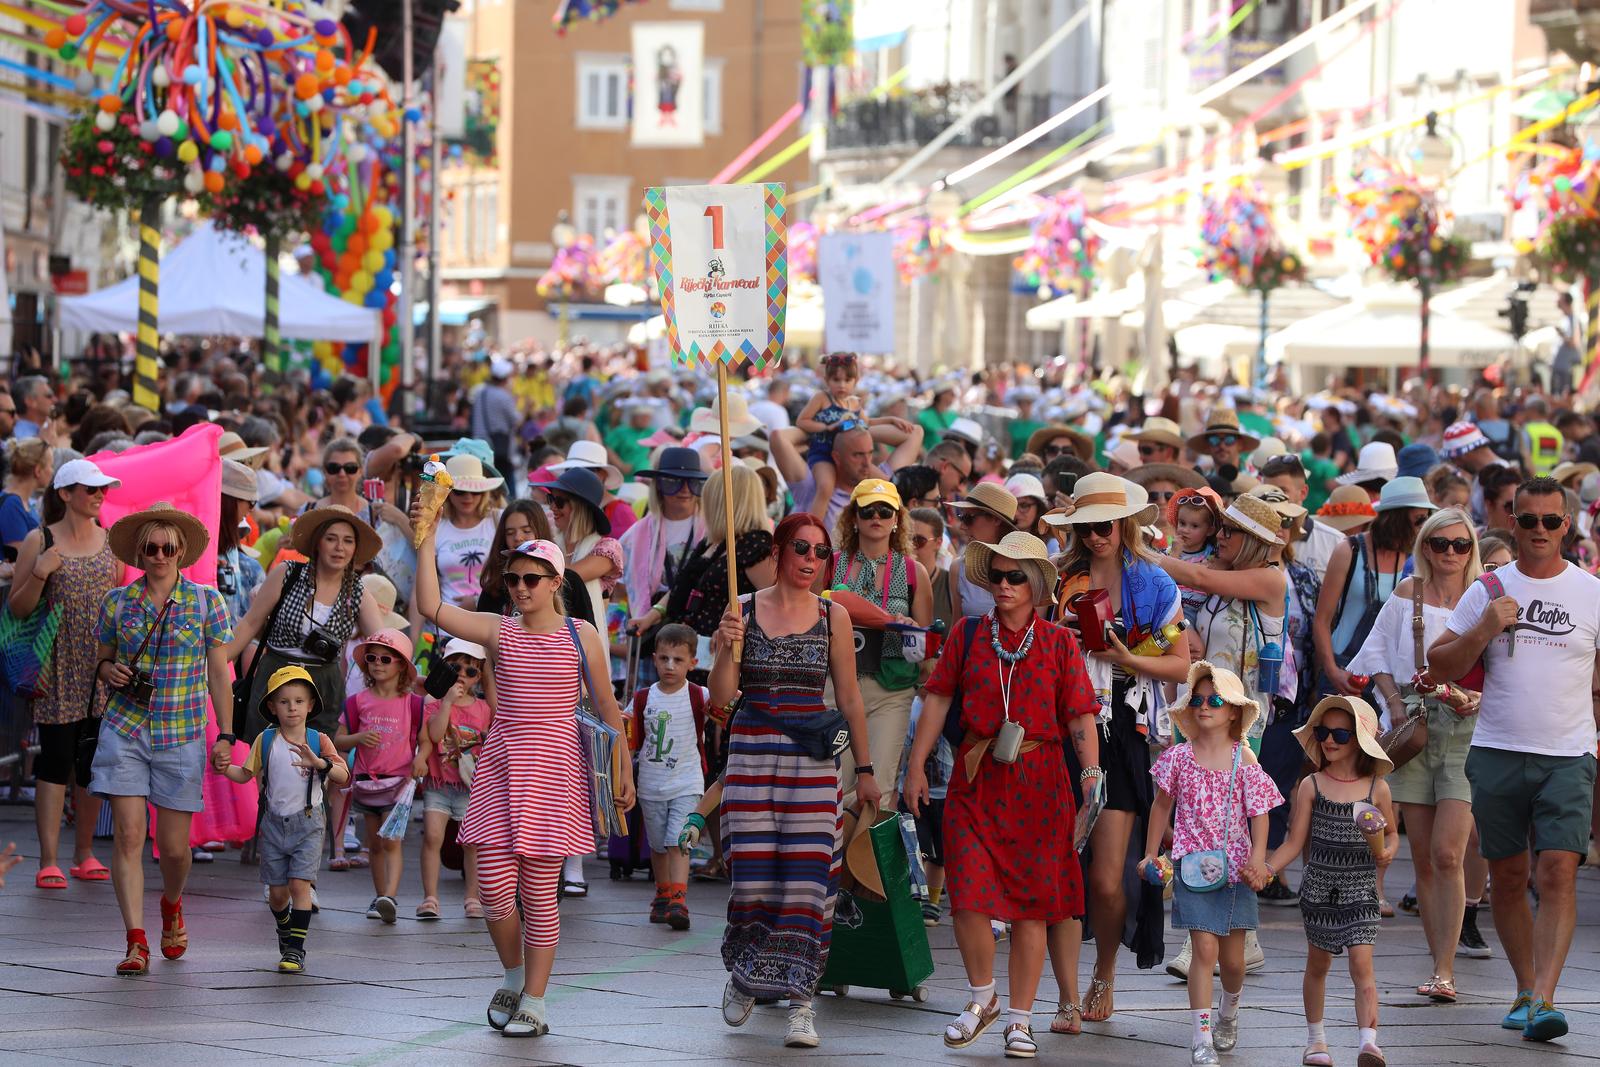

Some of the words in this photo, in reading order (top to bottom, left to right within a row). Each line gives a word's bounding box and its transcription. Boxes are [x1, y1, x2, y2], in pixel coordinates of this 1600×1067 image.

[703, 205, 725, 250] 1
[713, 275, 760, 291] Karneval
[1525, 599, 1571, 630] Cooper
[492, 993, 518, 1011] EACH
[512, 1013, 540, 1027] EACH
